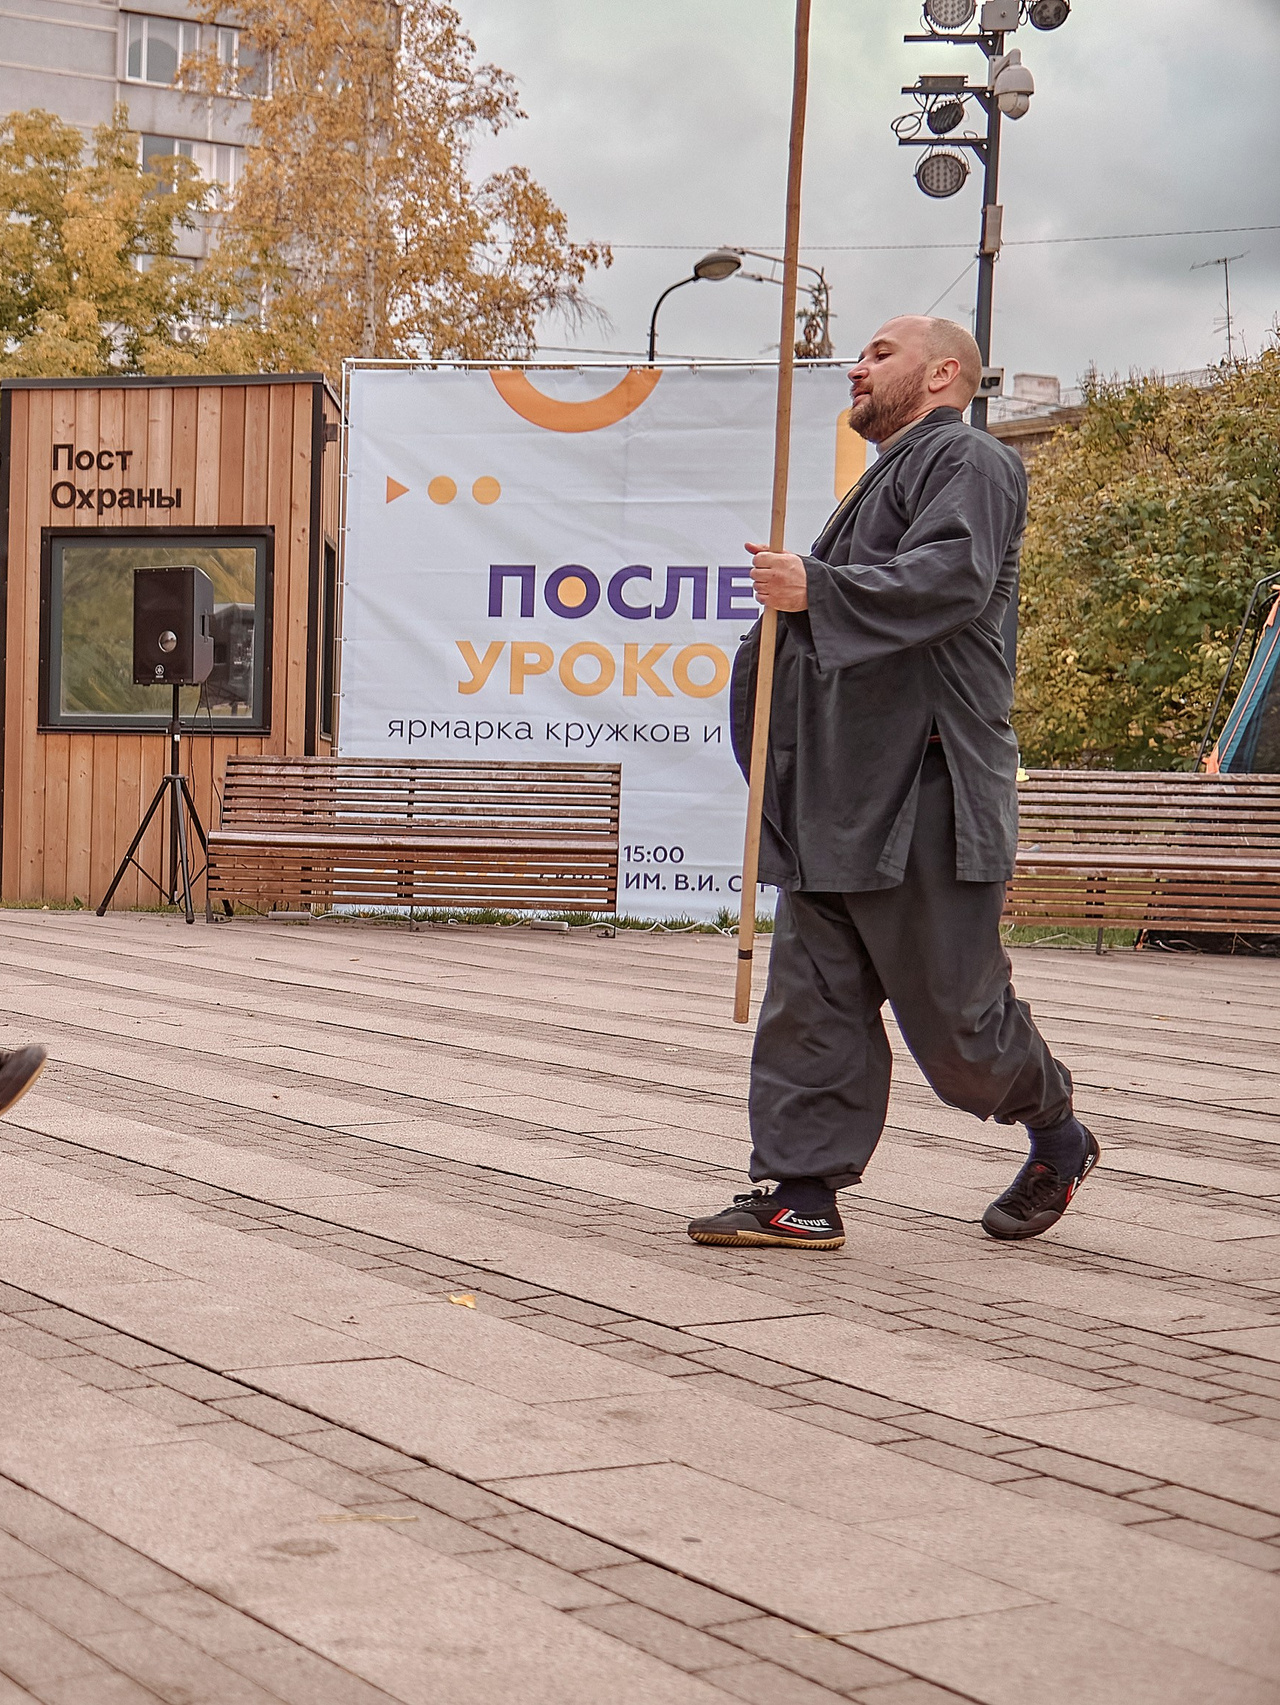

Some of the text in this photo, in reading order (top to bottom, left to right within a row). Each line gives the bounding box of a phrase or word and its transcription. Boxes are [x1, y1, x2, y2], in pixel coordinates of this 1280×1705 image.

[52, 443, 134, 471] Пост
[51, 480, 182, 516] Охраны
[487, 564, 760, 620] ПОСЛЕ
[455, 640, 731, 699] УРОКО
[388, 718, 722, 748] ярмарка кружков и
[623, 845, 685, 863] 15:00
[625, 872, 667, 891] ИМ.
[674, 874, 721, 892] В.И.
[791, 1216, 830, 1226] FEIYUE
